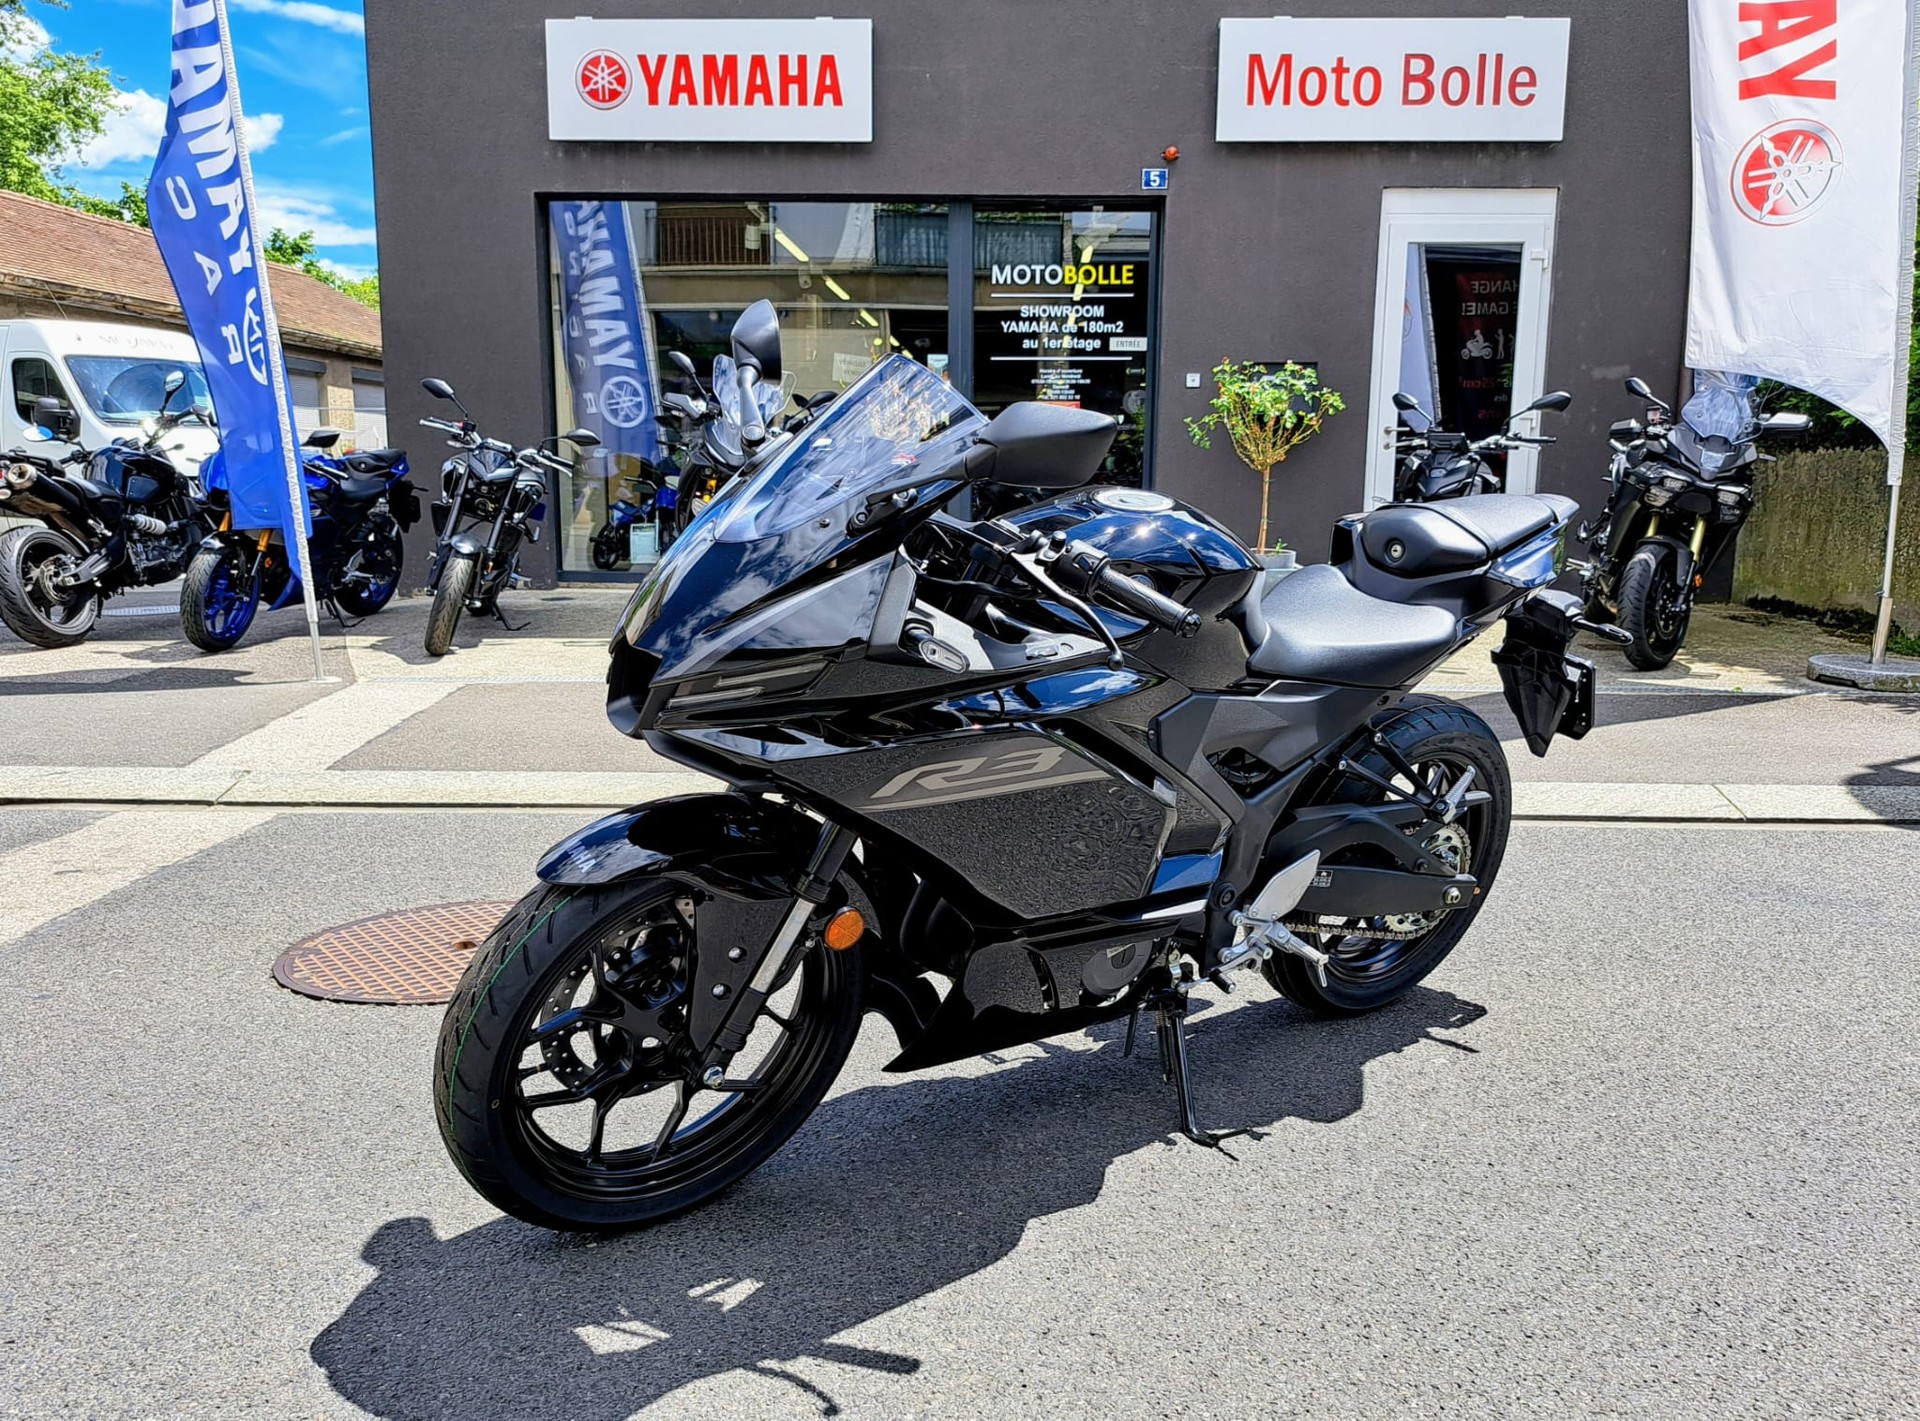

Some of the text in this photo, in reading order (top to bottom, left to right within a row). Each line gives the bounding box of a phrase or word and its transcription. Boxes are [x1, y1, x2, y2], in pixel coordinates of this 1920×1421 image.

[637, 54, 844, 108] YAMAHA
[1246, 53, 1537, 108] Moto Bolle
[1150, 171, 1160, 187] 5
[1020, 305, 1105, 318] SHOWROOM
[1000, 321, 1124, 333] YAMAHA de 180m2
[1022, 339, 1039, 349] au
[1042, 336, 1062, 349] 1er
[870, 746, 1067, 798] R3
